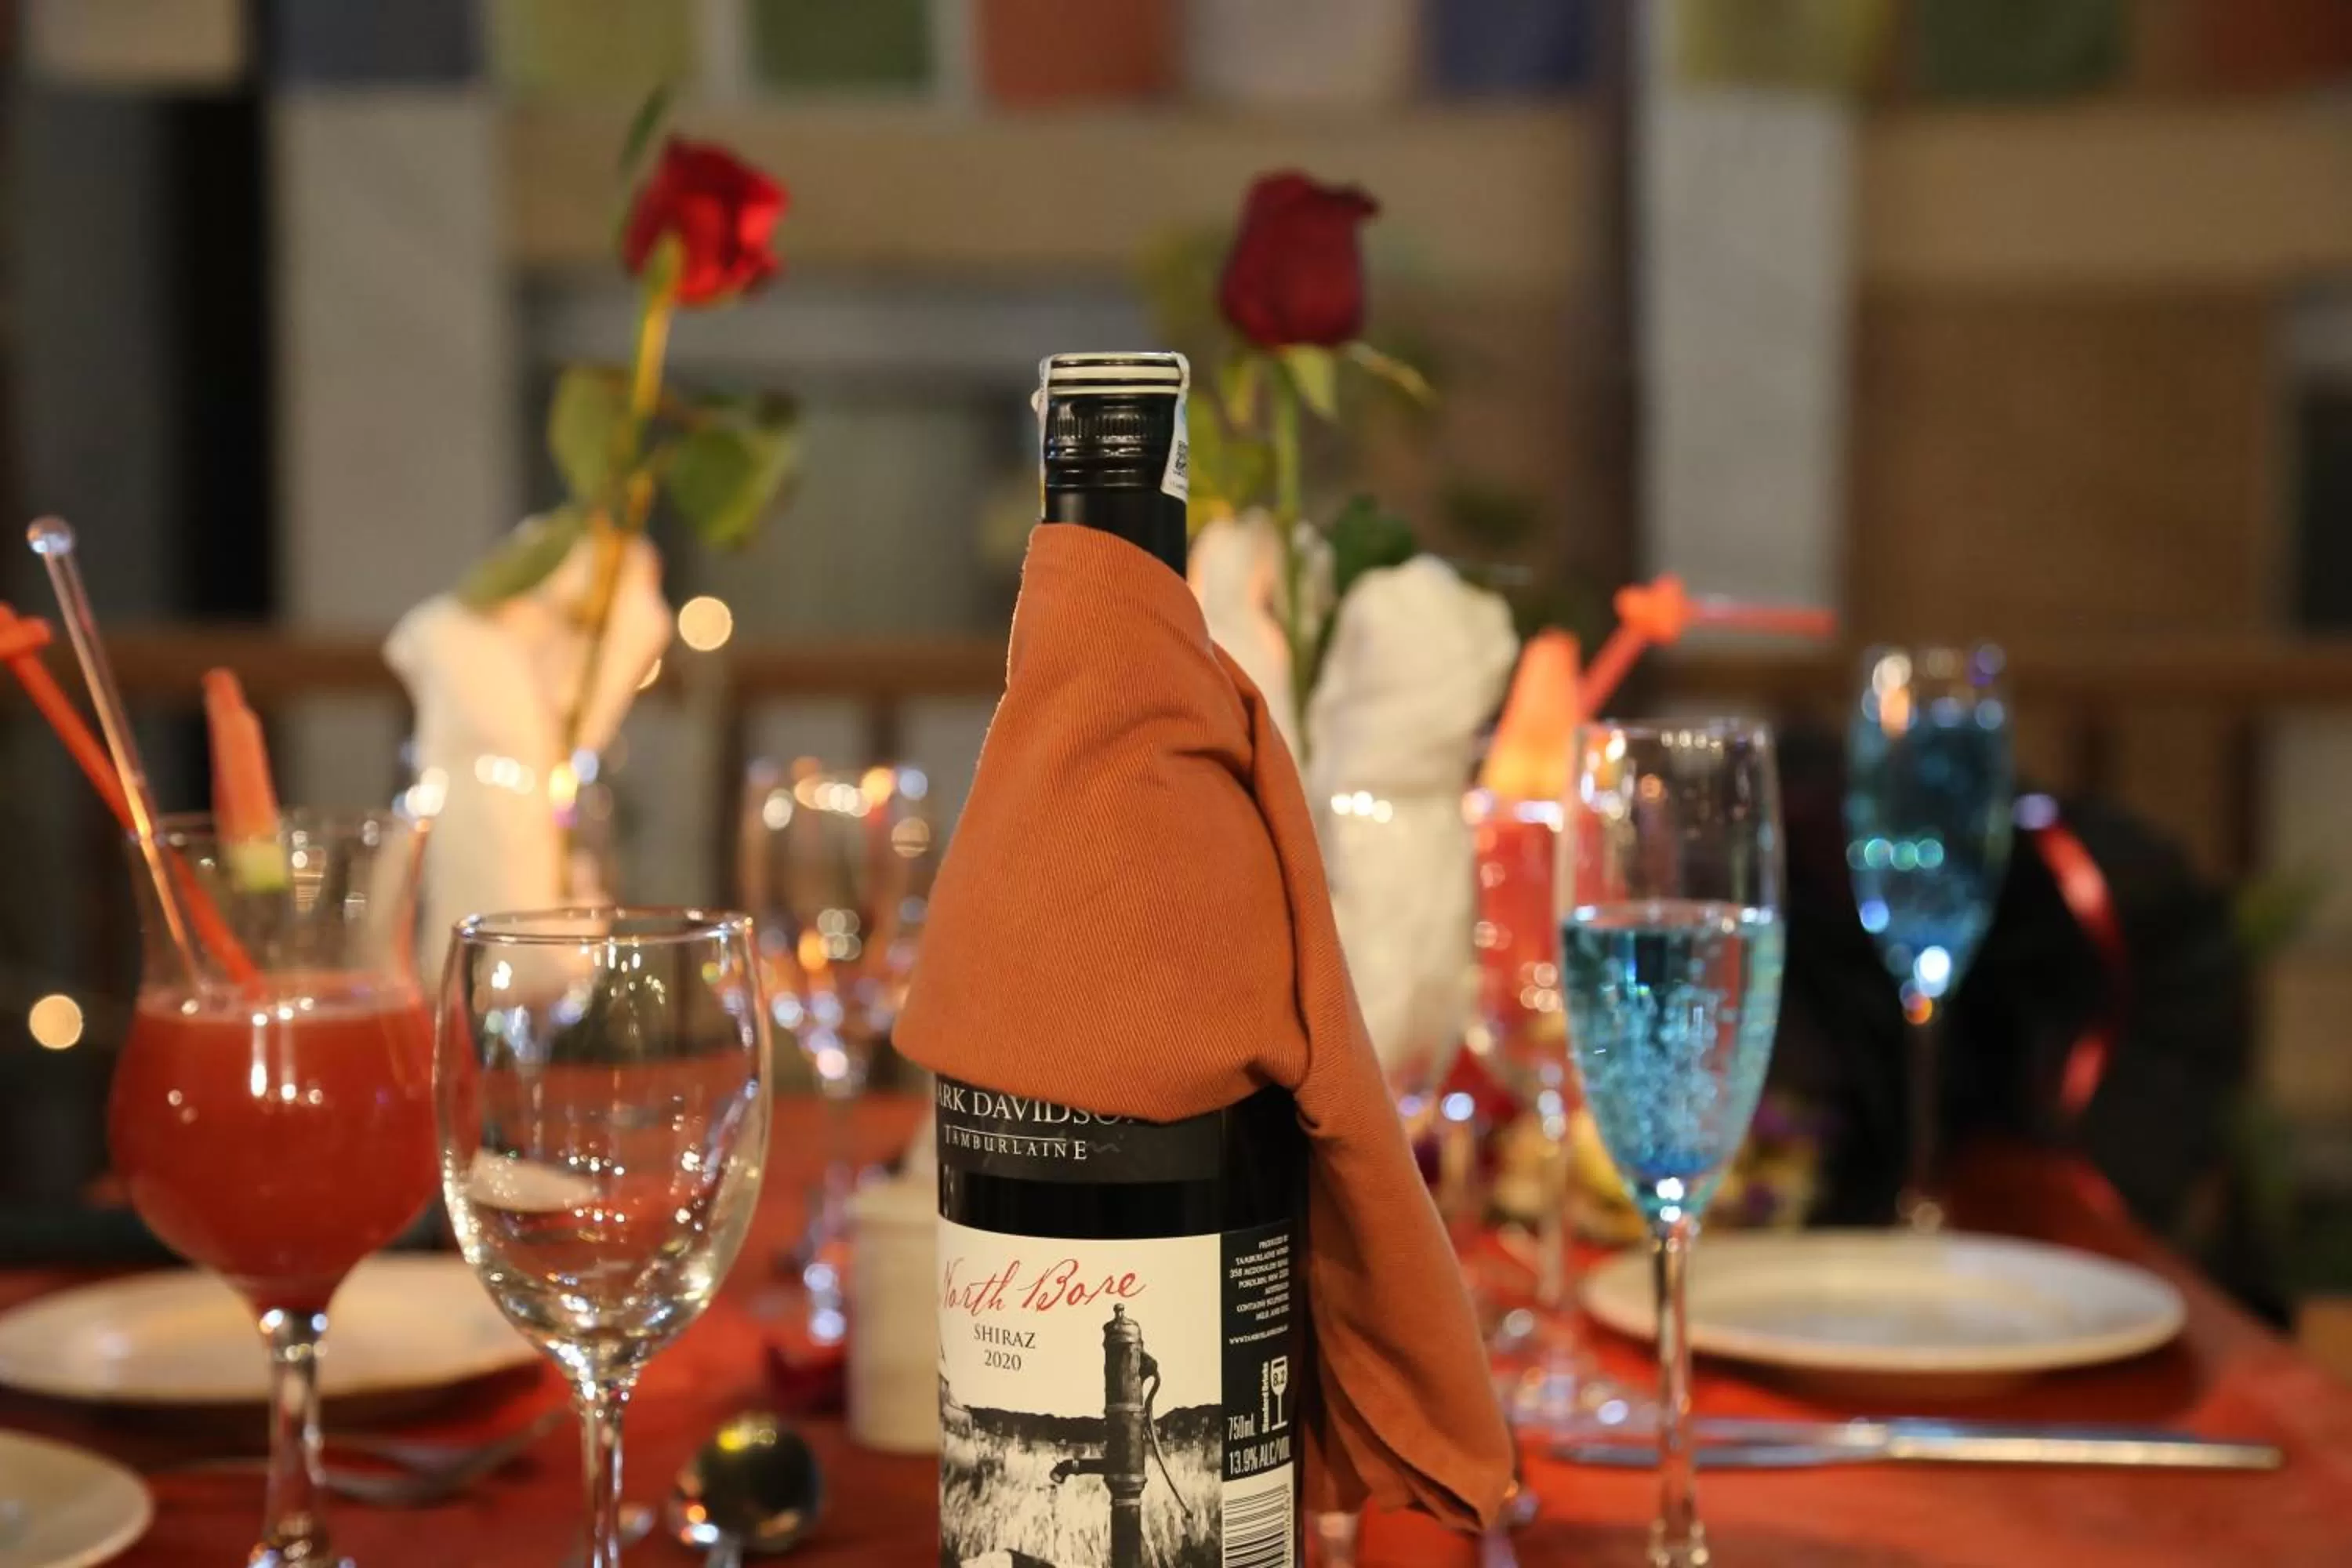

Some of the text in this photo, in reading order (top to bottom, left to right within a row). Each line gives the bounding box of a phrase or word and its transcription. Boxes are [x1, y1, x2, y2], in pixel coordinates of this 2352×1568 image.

[972, 1091, 1134, 1125] DAVIDS
[944, 1124, 1087, 1160] TAMBURLAINE
[943, 1257, 1145, 1316] North Bore
[974, 1324, 1036, 1349] SHIRAZ
[984, 1350, 1022, 1372] 2020
[1229, 1445, 1258, 1475] 13.9%
